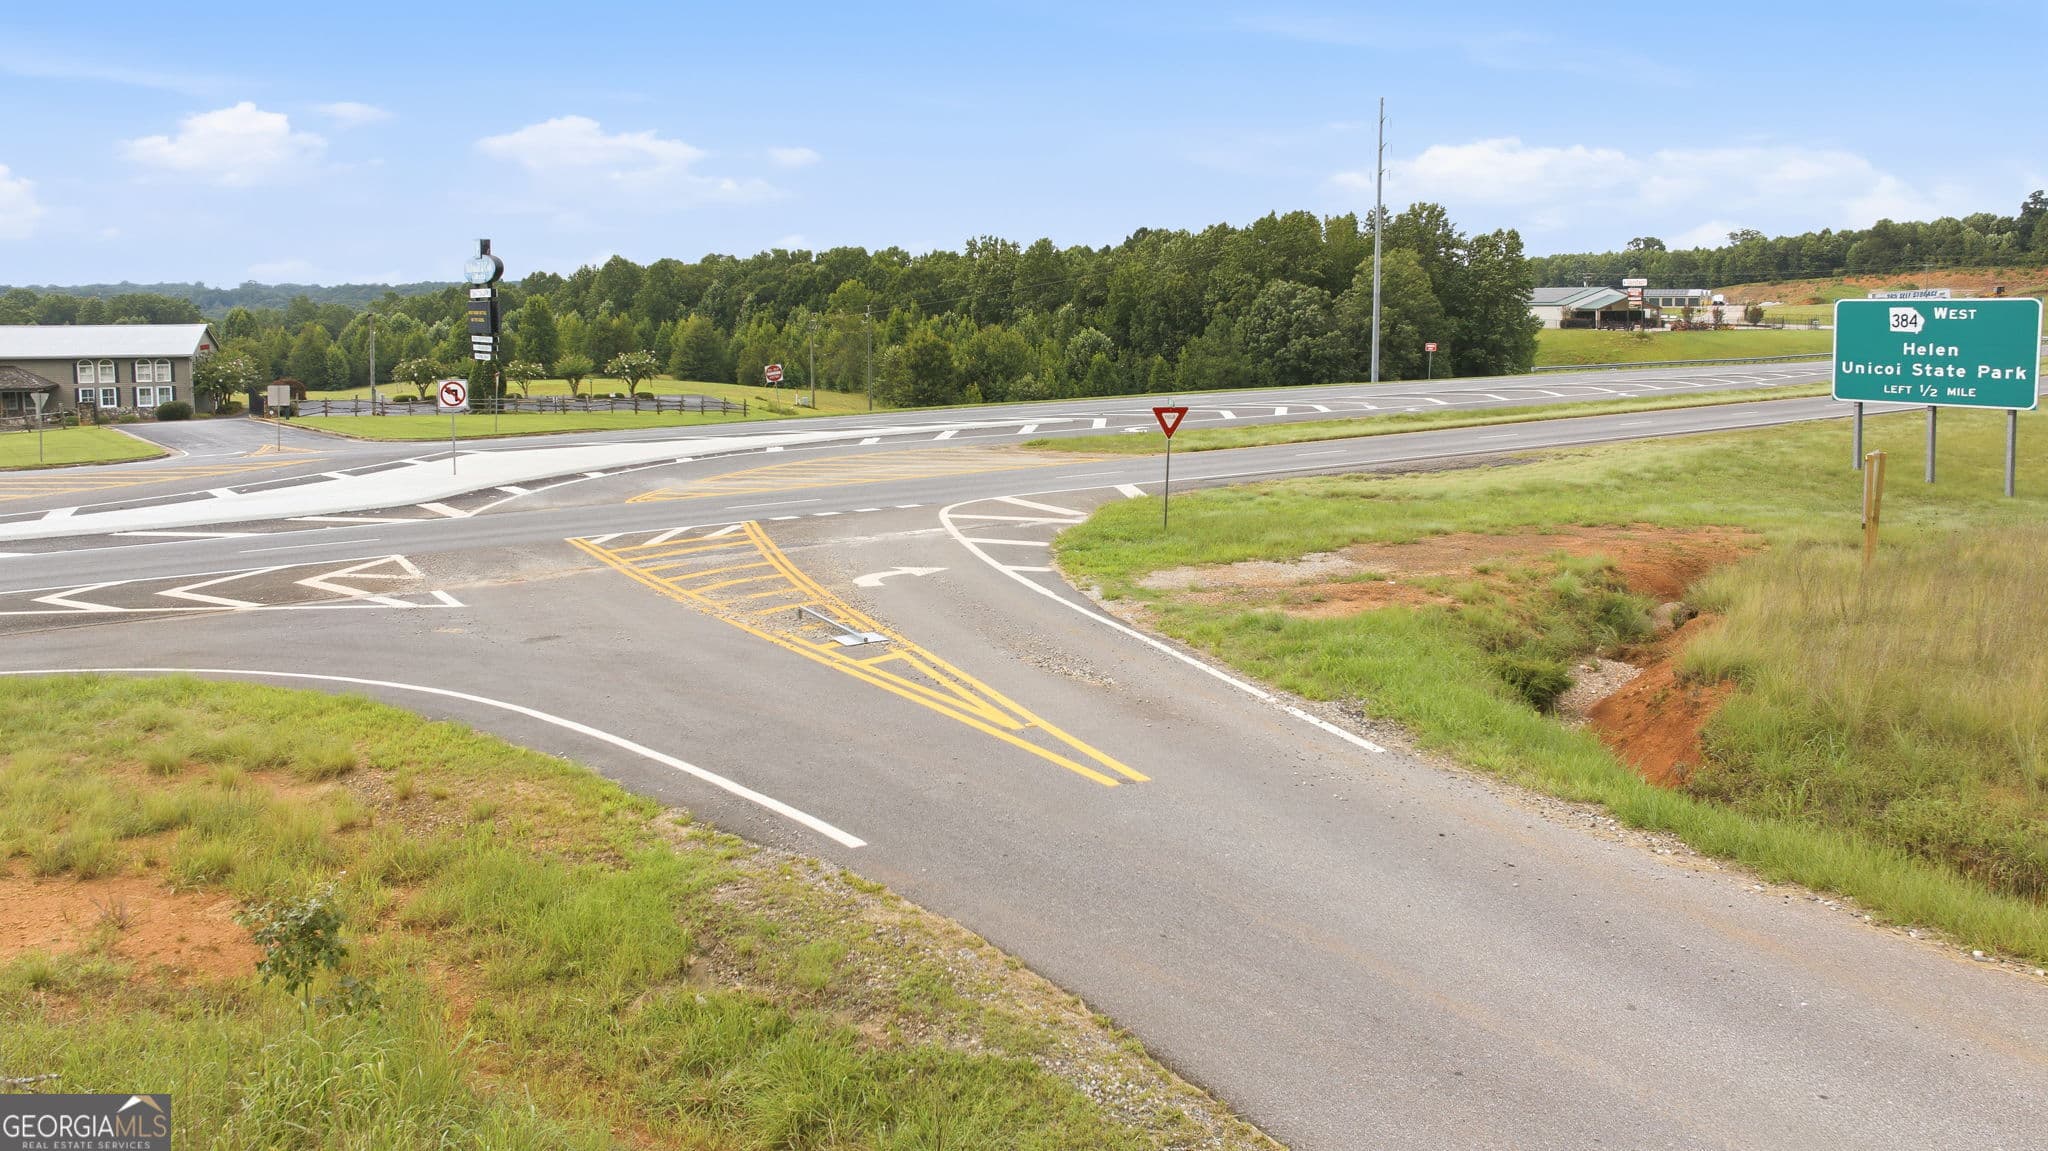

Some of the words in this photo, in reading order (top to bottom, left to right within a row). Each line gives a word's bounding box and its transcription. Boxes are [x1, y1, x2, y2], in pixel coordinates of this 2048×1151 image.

[1891, 313, 1918, 328] 384
[1933, 306, 1977, 320] WEST
[1903, 342, 1959, 357] Helen
[1841, 360, 1901, 376] Unicoi
[1911, 362, 1967, 379] State
[1977, 364, 2027, 380] Park
[1883, 384, 1913, 395] LEFT
[1946, 387, 1977, 398] MILE
